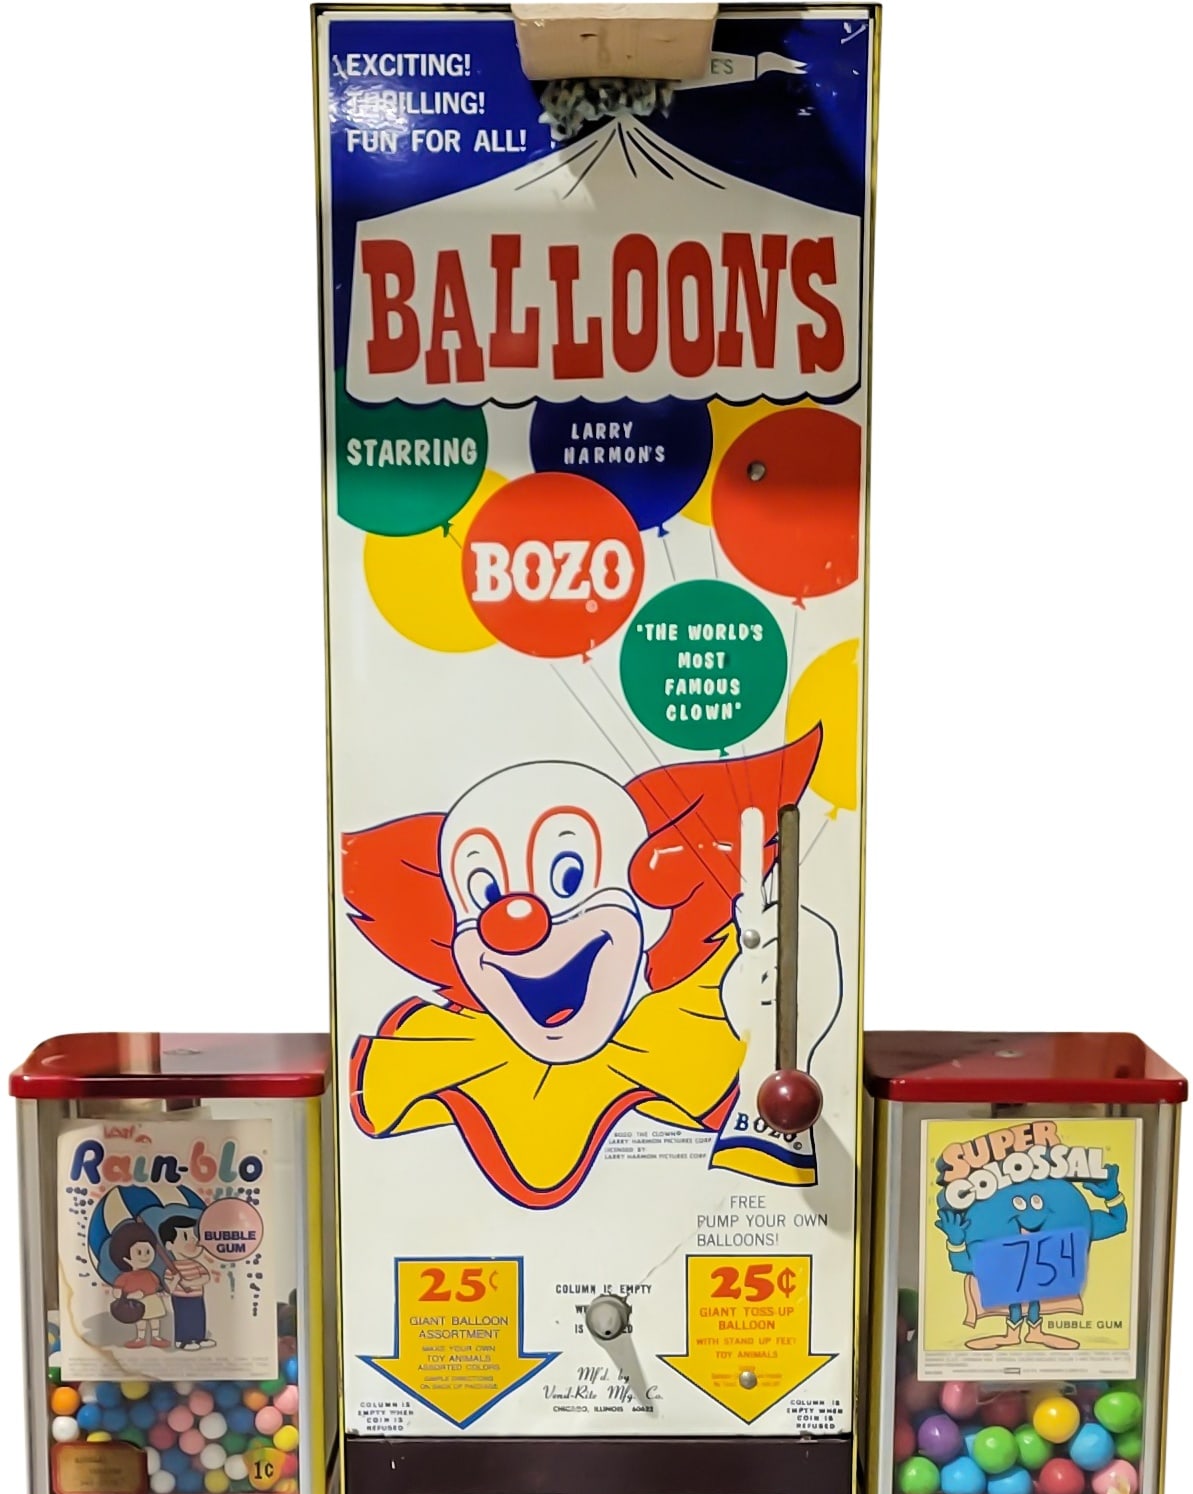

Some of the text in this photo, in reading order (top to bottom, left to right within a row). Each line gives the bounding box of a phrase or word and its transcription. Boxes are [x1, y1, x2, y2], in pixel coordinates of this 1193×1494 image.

[347, 53, 471, 76] EXCITING!
[346, 91, 485, 115] THRILLING!
[347, 129, 527, 153] FUN FOR ALL!
[361, 232, 845, 385] BALLOONS
[571, 421, 633, 441] LARRY
[347, 437, 478, 467] STARRING
[564, 445, 666, 465] HARMON'S
[470, 538, 635, 603] BOZO
[688, 623, 764, 641] WORLD'S
[678, 651, 725, 669] MOST
[664, 678, 741, 696] FAMOUS
[941, 1120, 1062, 1182] SUPER
[945, 1144, 1109, 1210] COLOSSAL
[730, 1196, 767, 1209] FREE
[697, 1213, 828, 1228] PUMP YOUR OWN
[204, 1230, 256, 1241] BUBBLE
[697, 1232, 779, 1247] BALLOONS!
[216, 1243, 246, 1253] GUM
[1002, 1231, 1077, 1293] 754
[555, 1284, 596, 1294] COLUMN
[620, 1284, 652, 1294] EMPTY
[699, 1307, 737, 1317] GIANT
[409, 1315, 509, 1326] GIANT BALLOON
[718, 1320, 776, 1330] BALLOON
[1047, 1320, 1123, 1329] BUBBLE GUM
[419, 1329, 501, 1339] ASSORTMENT
[575, 1324, 584, 1334] IS
[696, 1337, 719, 1346] WITH
[724, 1337, 754, 1345] STAND
[759, 1337, 772, 1345] UP
[716, 1351, 778, 1359] TOY ANIMALS
[617, 1368, 630, 1385] by
[542, 1385, 598, 1400] Vend-Rite
